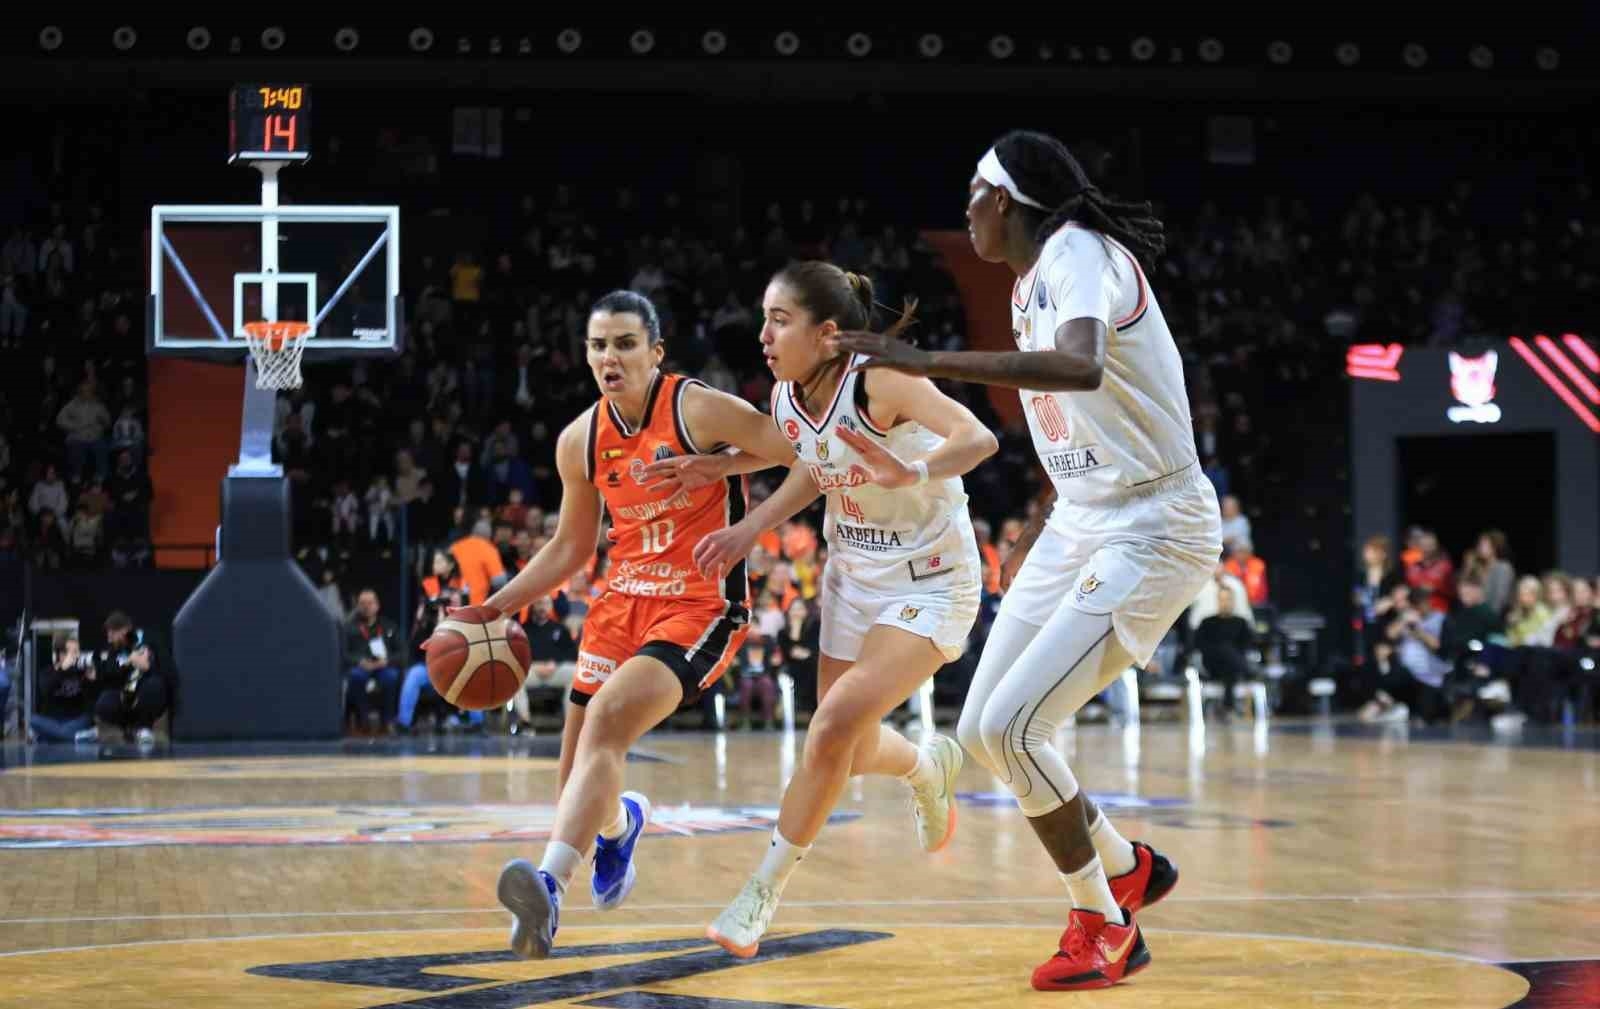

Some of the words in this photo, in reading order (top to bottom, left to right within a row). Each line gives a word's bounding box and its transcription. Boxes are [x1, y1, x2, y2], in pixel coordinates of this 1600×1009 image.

[259, 87, 302, 109] 7:40
[263, 114, 296, 152] 14
[1031, 394, 1069, 442] 00
[1048, 449, 1098, 473] ARBELLA
[839, 494, 865, 524] 4
[640, 519, 675, 554] 10
[836, 524, 902, 547] ARBELLA
